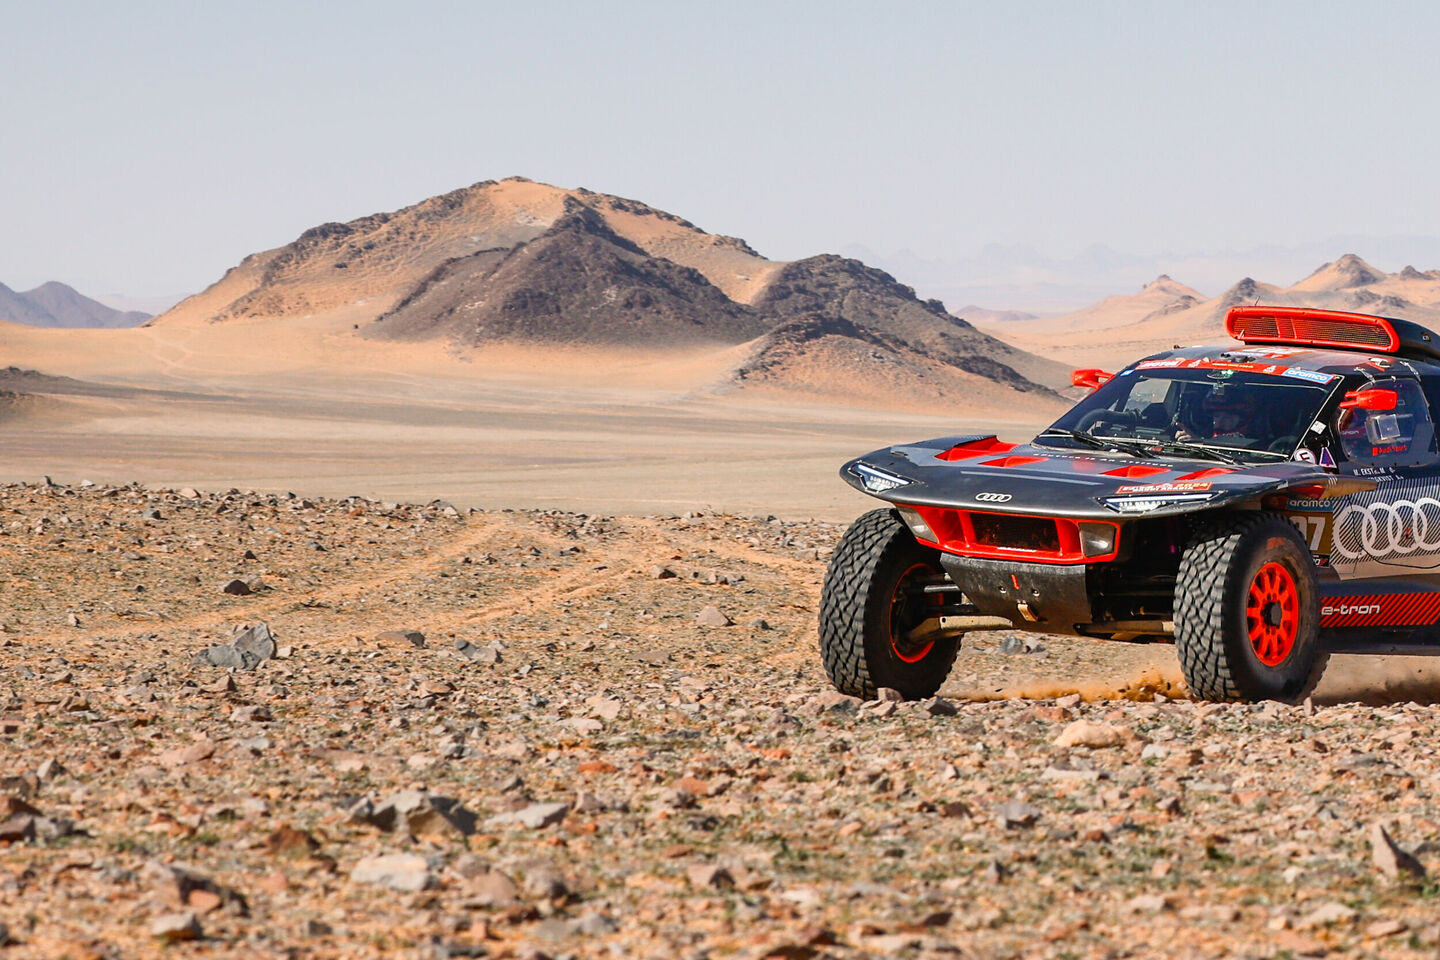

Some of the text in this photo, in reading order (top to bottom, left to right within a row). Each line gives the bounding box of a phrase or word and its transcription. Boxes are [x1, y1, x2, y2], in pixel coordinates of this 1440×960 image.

[1287, 369, 1329, 381] aramco
[1289, 499, 1331, 508] aramco
[1321, 604, 1380, 616] e-tron
